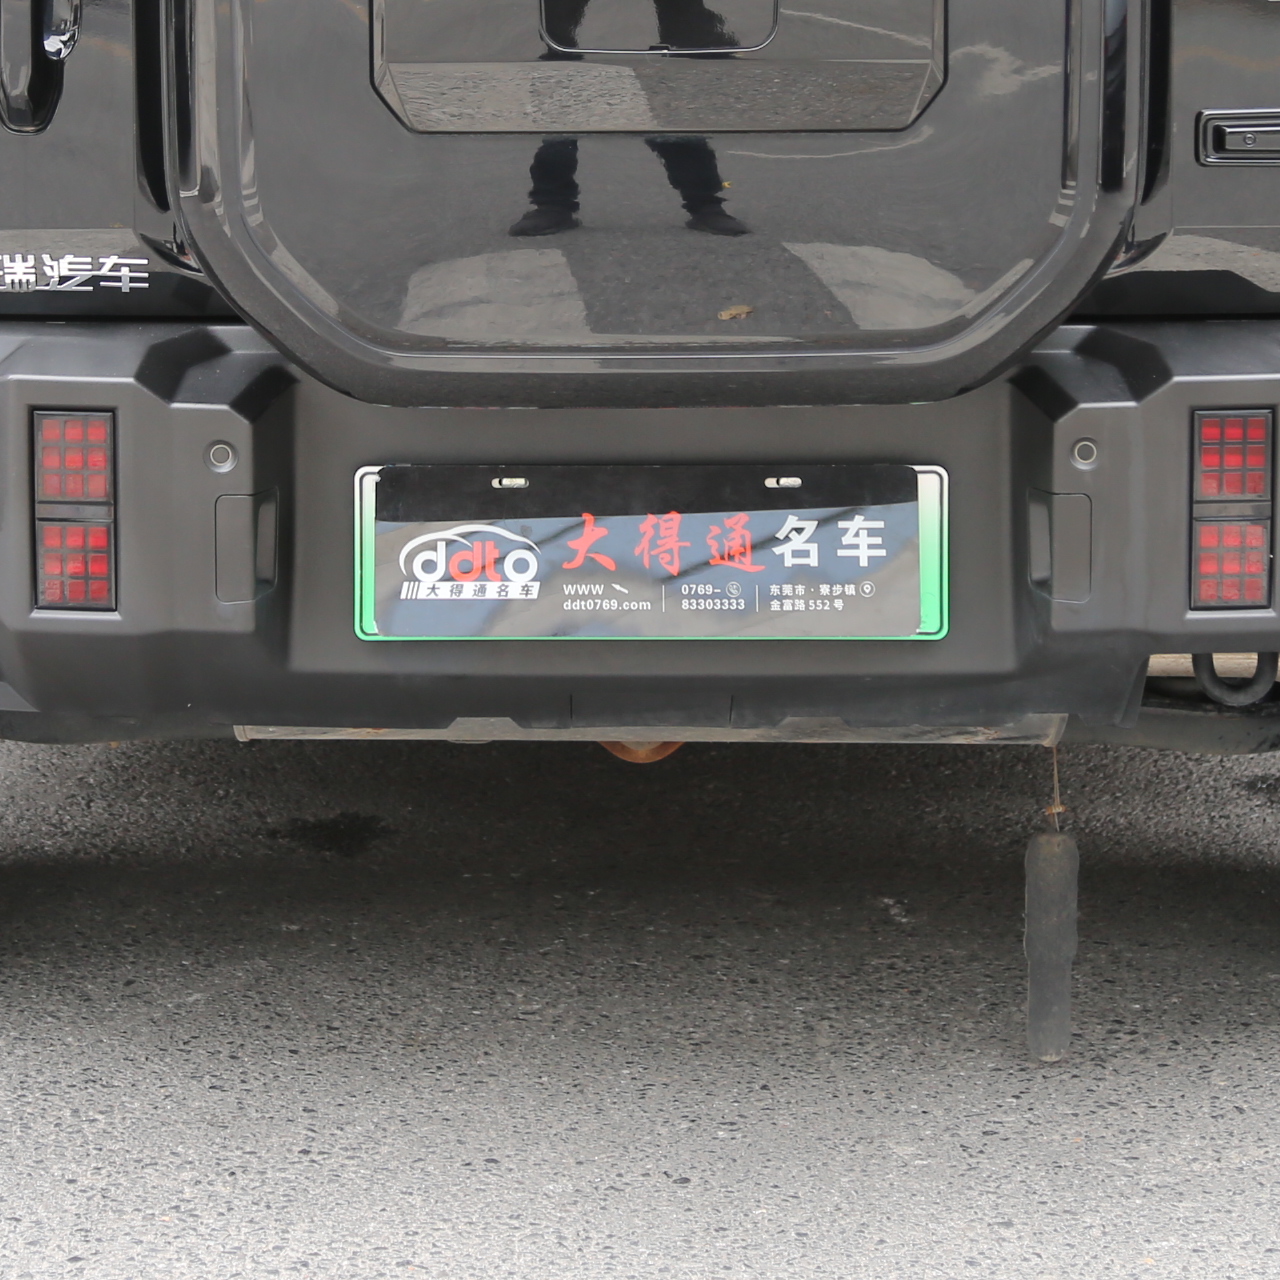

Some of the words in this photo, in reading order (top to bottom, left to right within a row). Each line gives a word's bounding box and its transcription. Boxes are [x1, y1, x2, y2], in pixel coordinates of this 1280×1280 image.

[562, 511, 887, 576] 大得通名车
[425, 583, 535, 598] 大得通名车
[563, 599, 652, 611] ddt0769.com
[681, 599, 746, 610] 83303333
